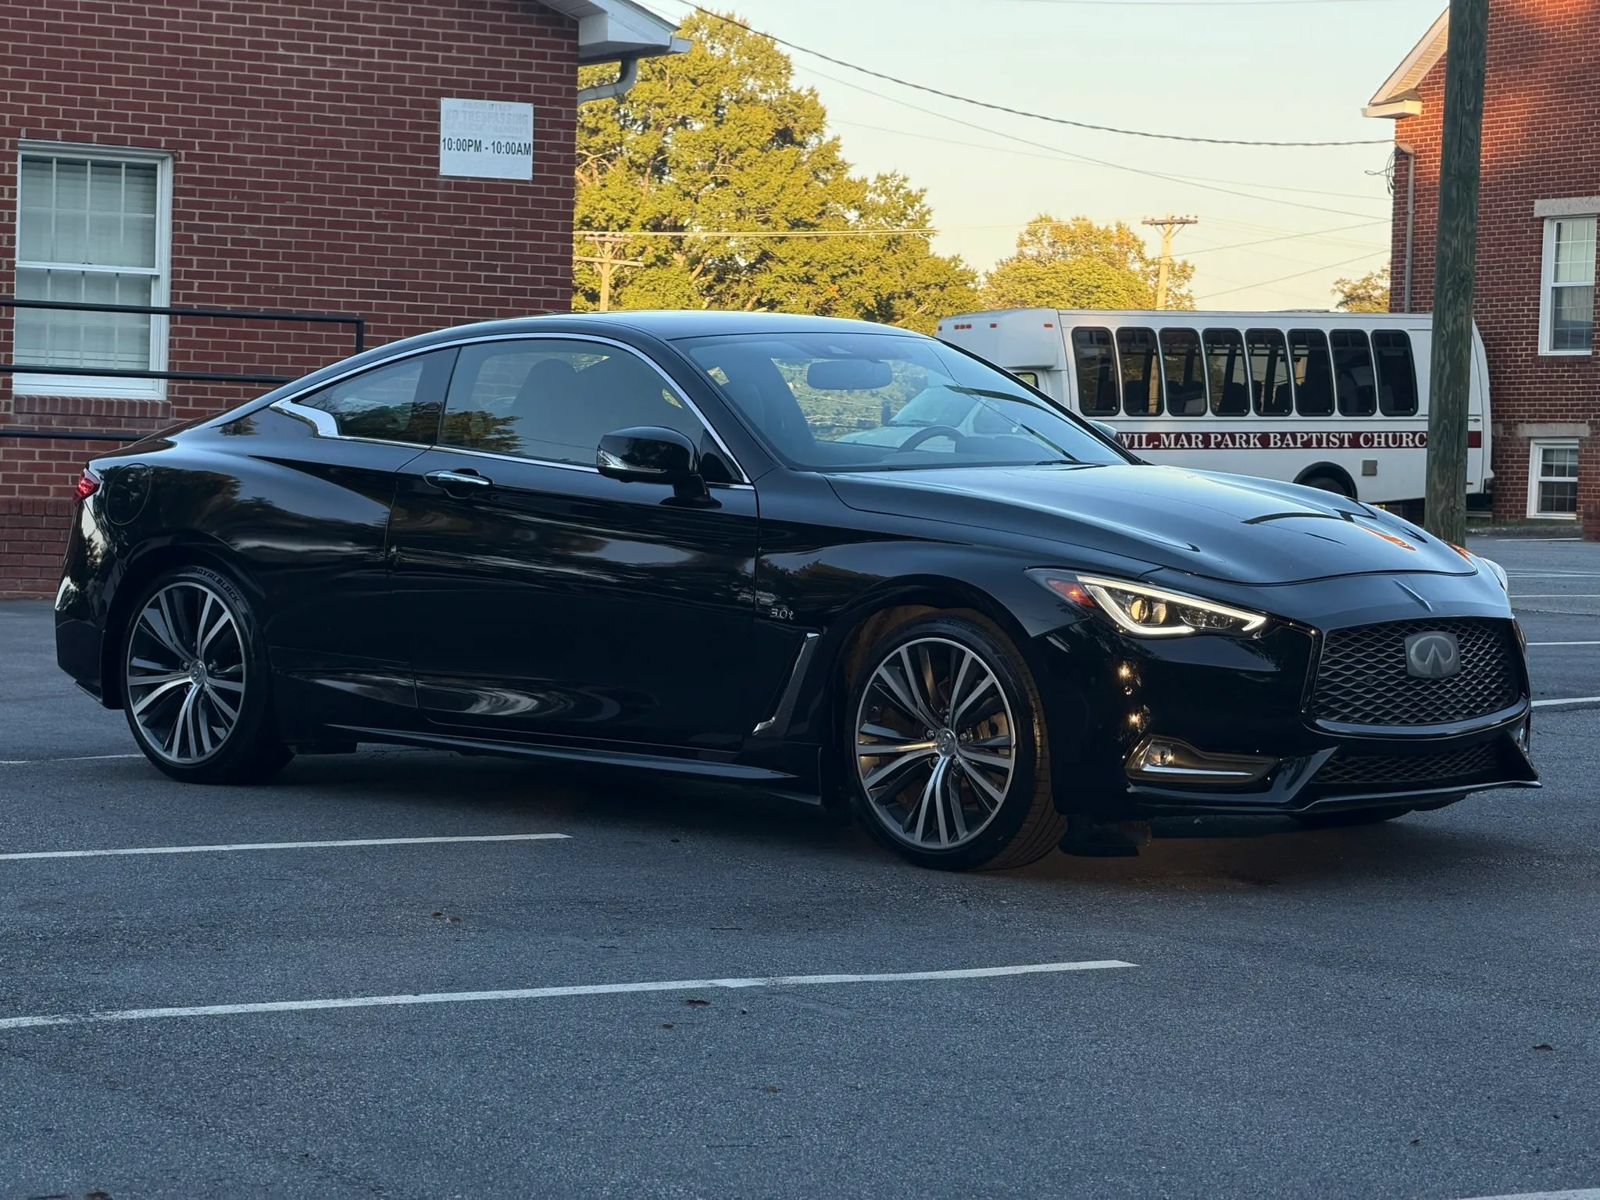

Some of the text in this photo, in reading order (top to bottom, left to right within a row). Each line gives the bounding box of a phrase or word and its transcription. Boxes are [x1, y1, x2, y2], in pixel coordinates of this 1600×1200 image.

[442, 137, 482, 152] 10:00PM
[491, 141, 532, 156] 10:00AM
[1118, 432, 1427, 449] WIL-MAR PARK BAPTIST CHURC
